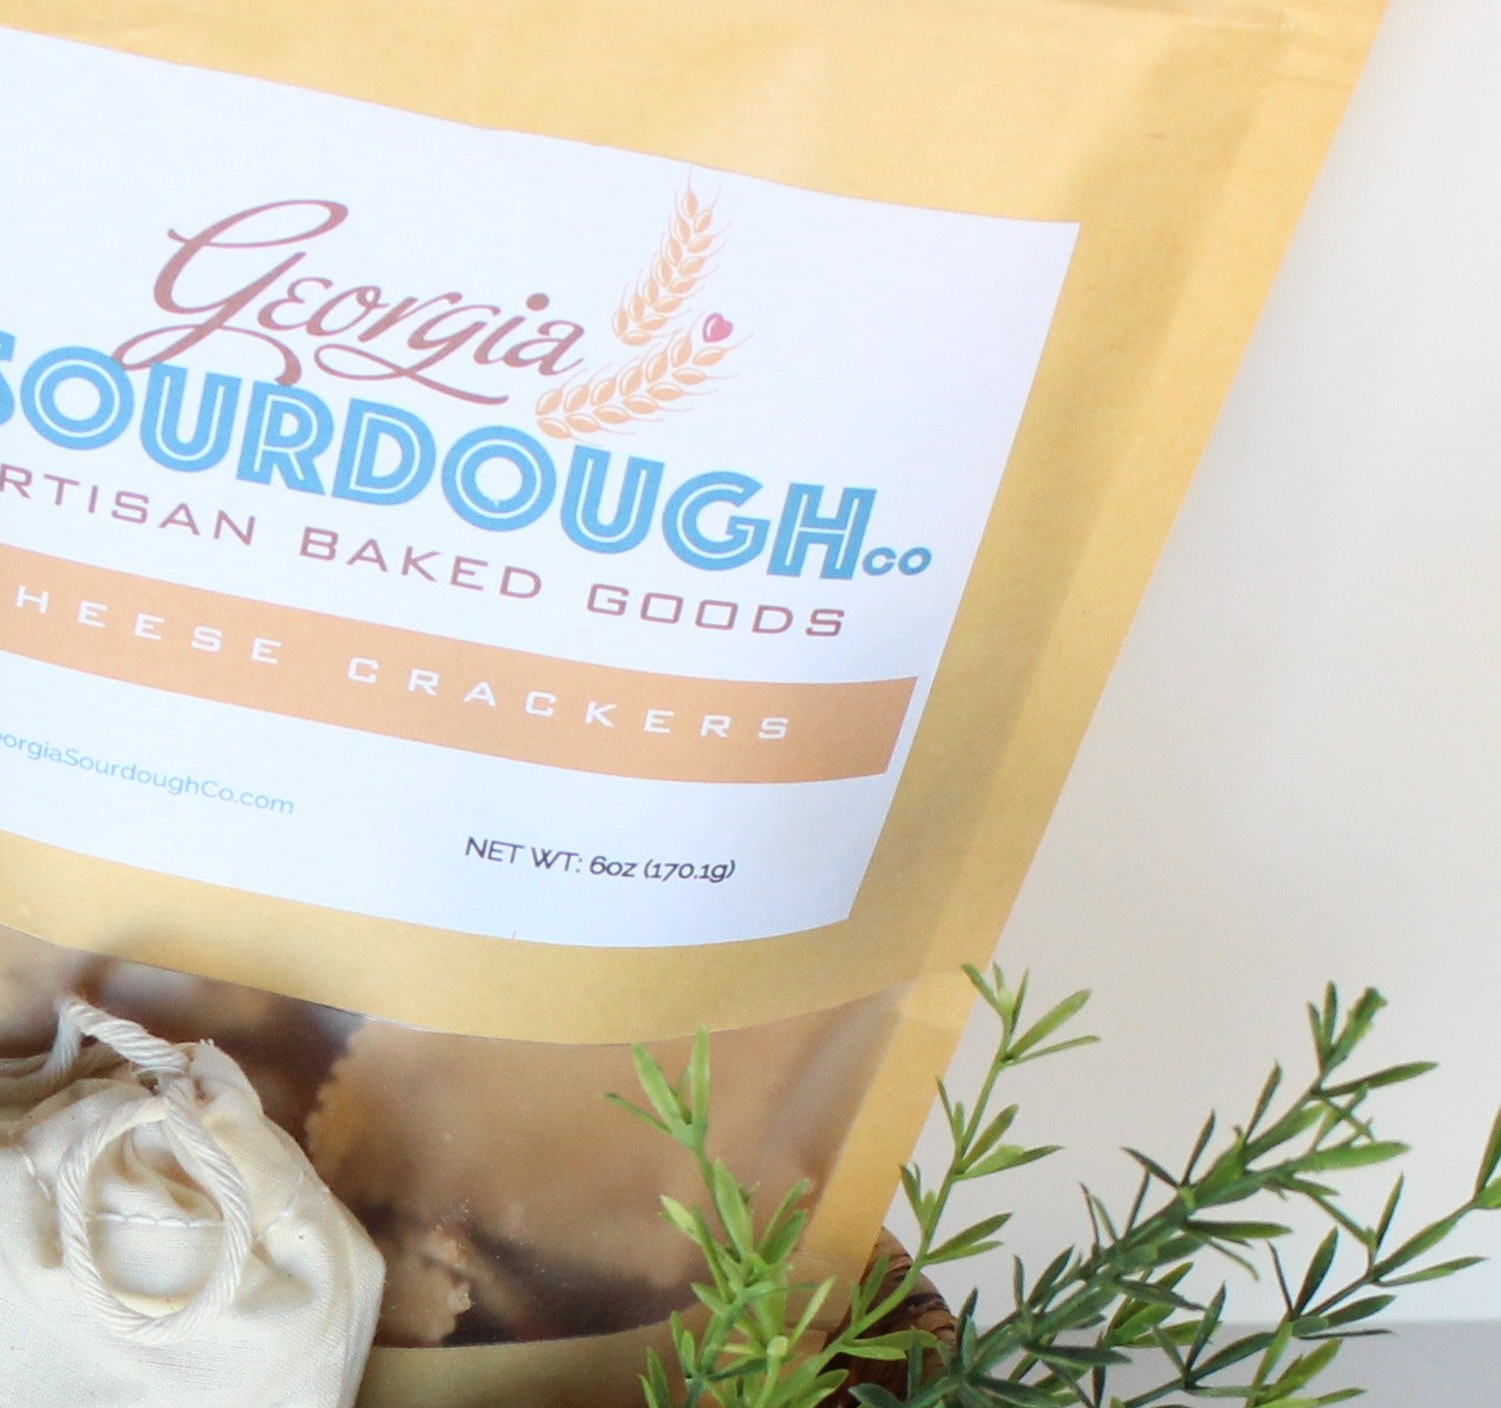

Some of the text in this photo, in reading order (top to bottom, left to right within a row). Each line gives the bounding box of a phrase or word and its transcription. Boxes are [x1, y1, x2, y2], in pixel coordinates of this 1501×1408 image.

[111, 199, 586, 406] Georgia
[300, 526, 542, 600] BAKED
[587, 584, 845, 638] GOODS
[347, 656, 790, 740] CRACKERS
[464, 836, 737, 884] NET WT: 6oz (170.1g)
